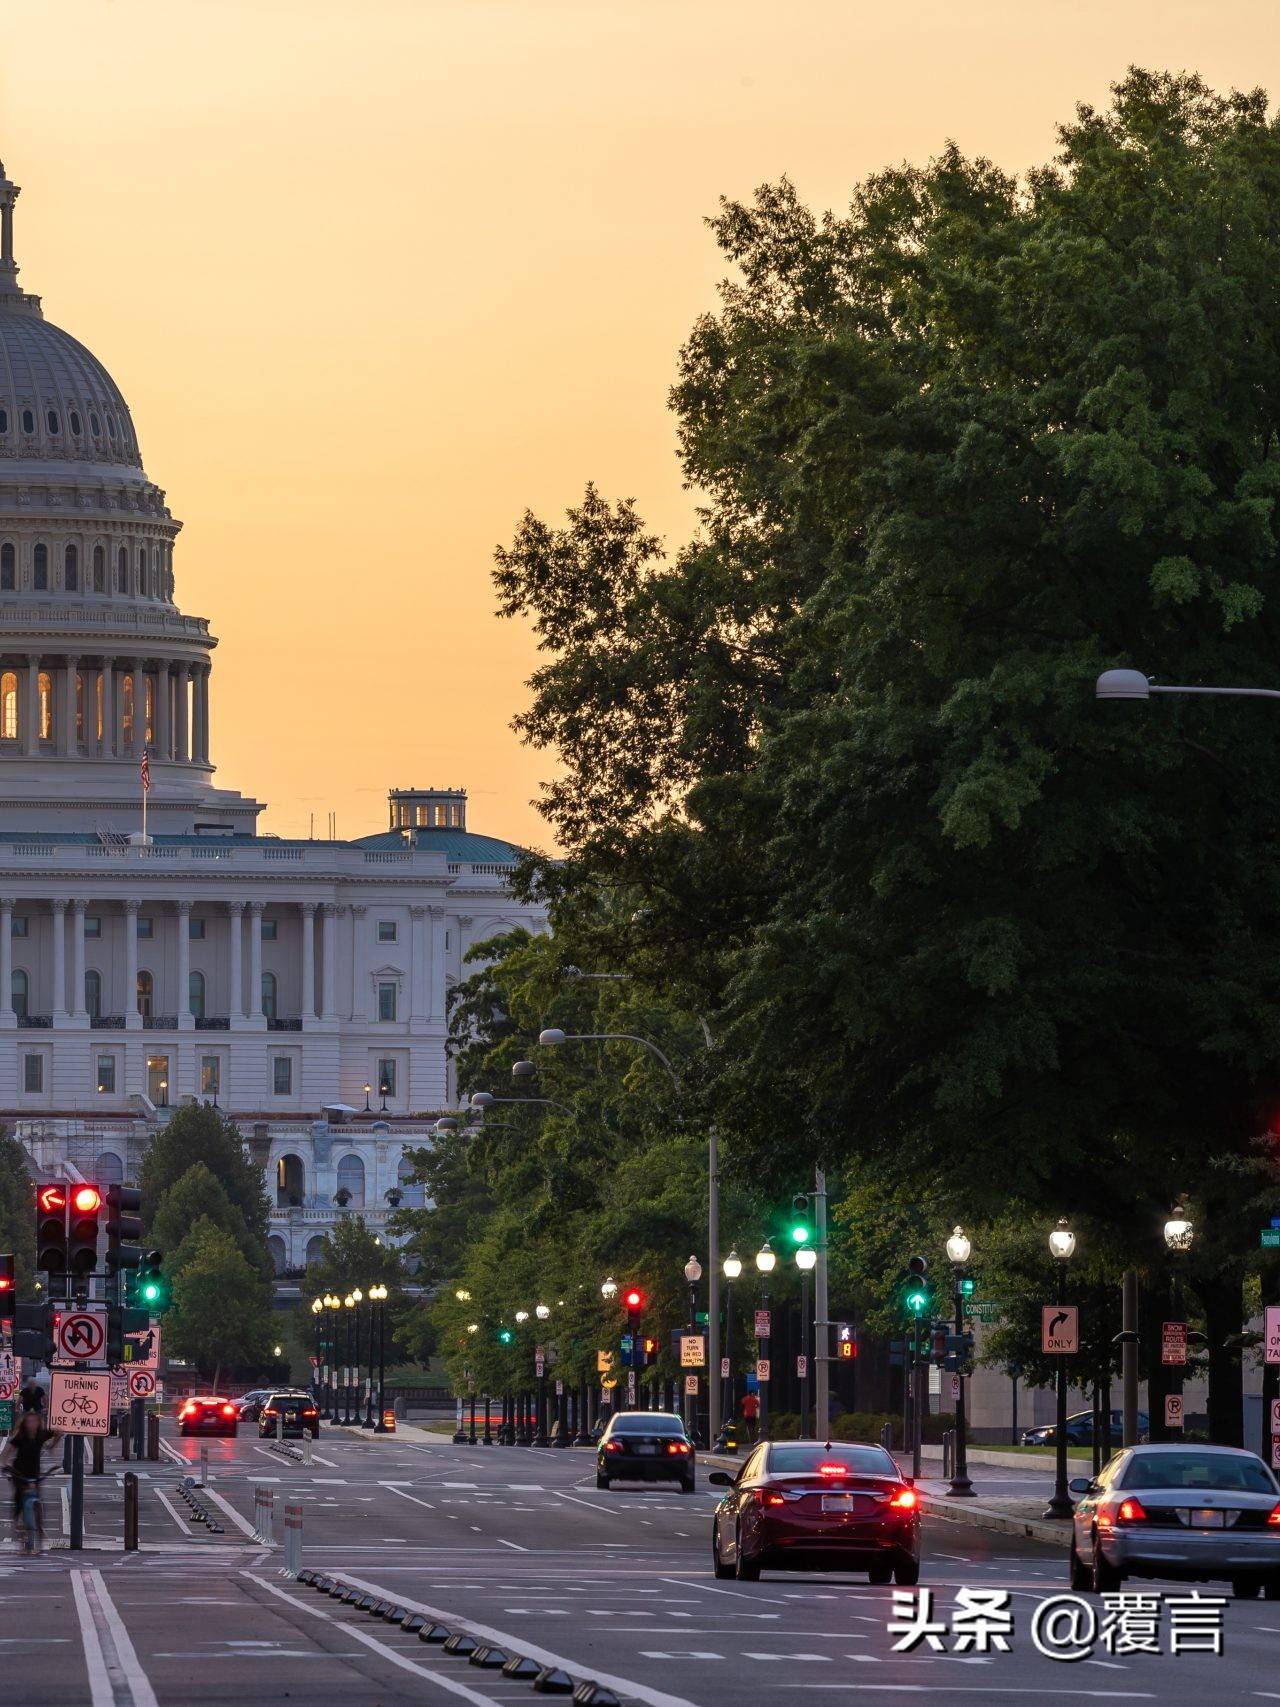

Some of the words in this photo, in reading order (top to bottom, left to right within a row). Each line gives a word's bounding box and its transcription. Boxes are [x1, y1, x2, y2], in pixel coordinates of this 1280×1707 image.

[1047, 1339, 1073, 1349] ONLY
[64, 1379, 99, 1391] TURNING
[51, 1416, 68, 1426] USE
[71, 1417, 107, 1428] X-WALKS
